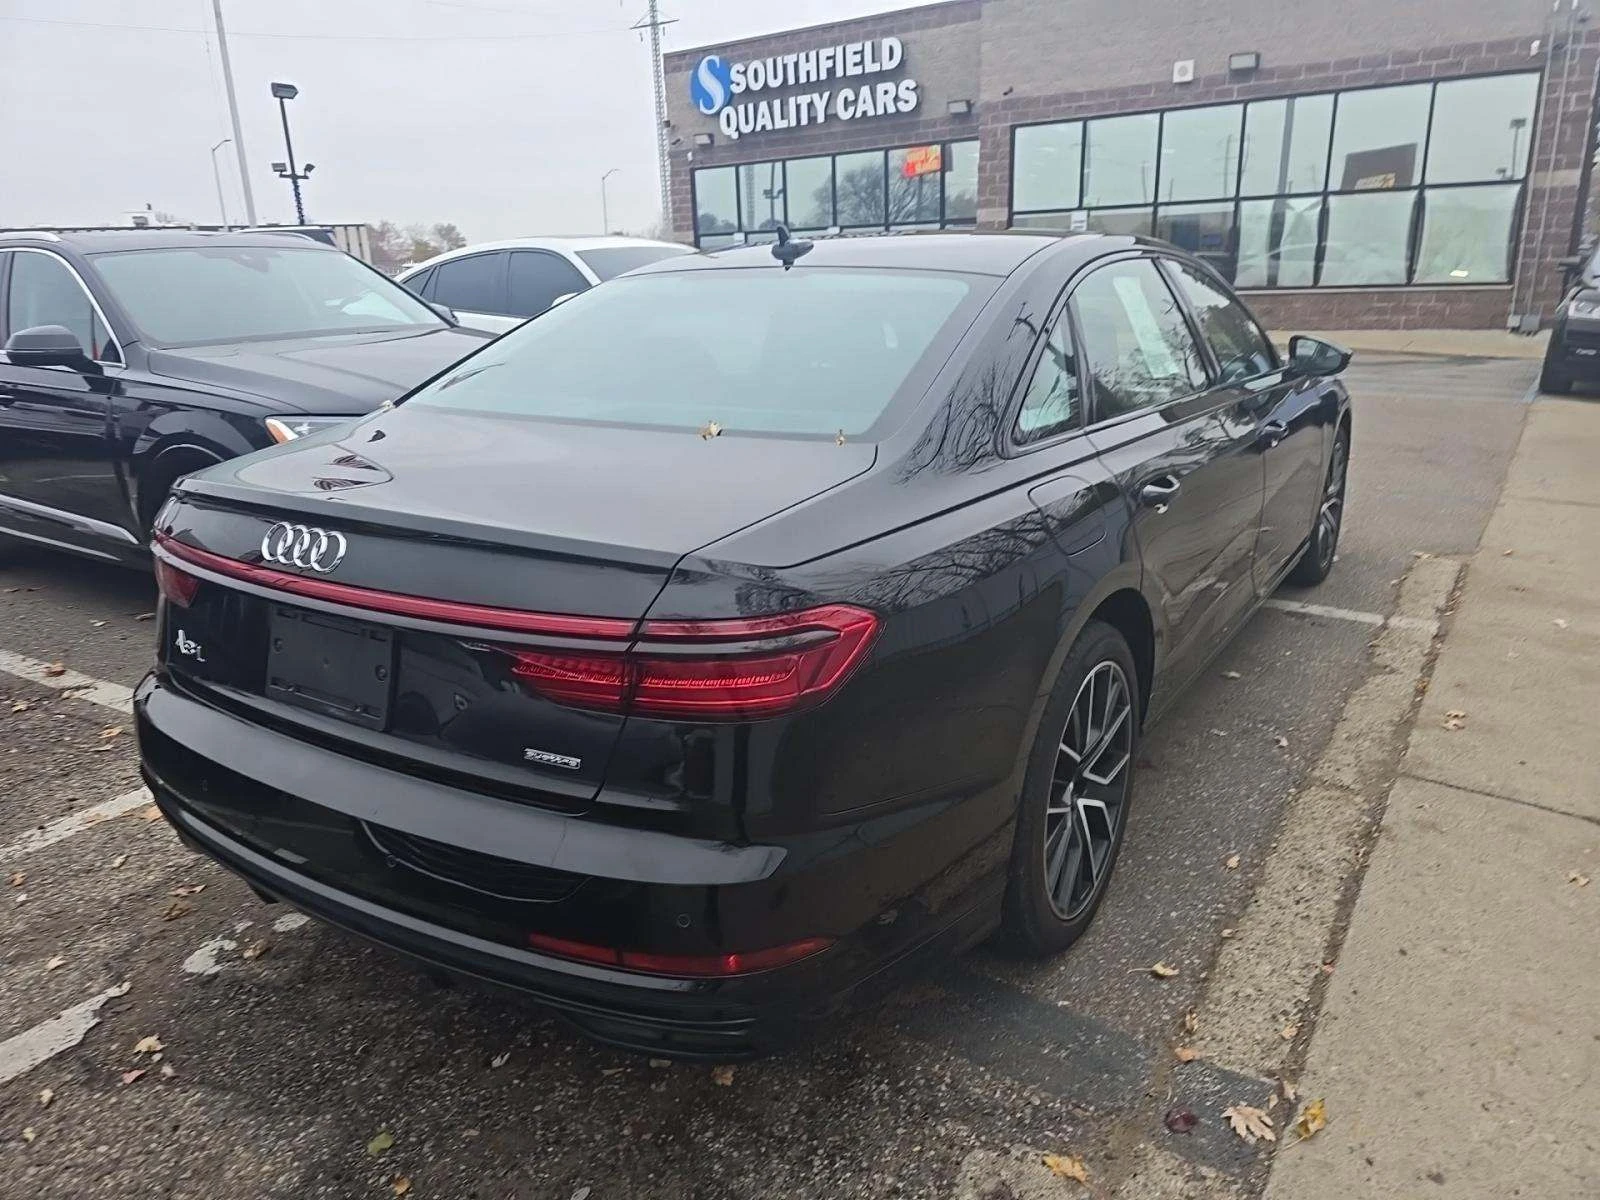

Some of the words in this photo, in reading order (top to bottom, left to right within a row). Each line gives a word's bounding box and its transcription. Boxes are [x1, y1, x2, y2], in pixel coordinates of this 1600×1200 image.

[729, 37, 904, 95] SOUTHFIELD
[719, 90, 833, 140] QUALITY
[836, 79, 918, 121] CARS
